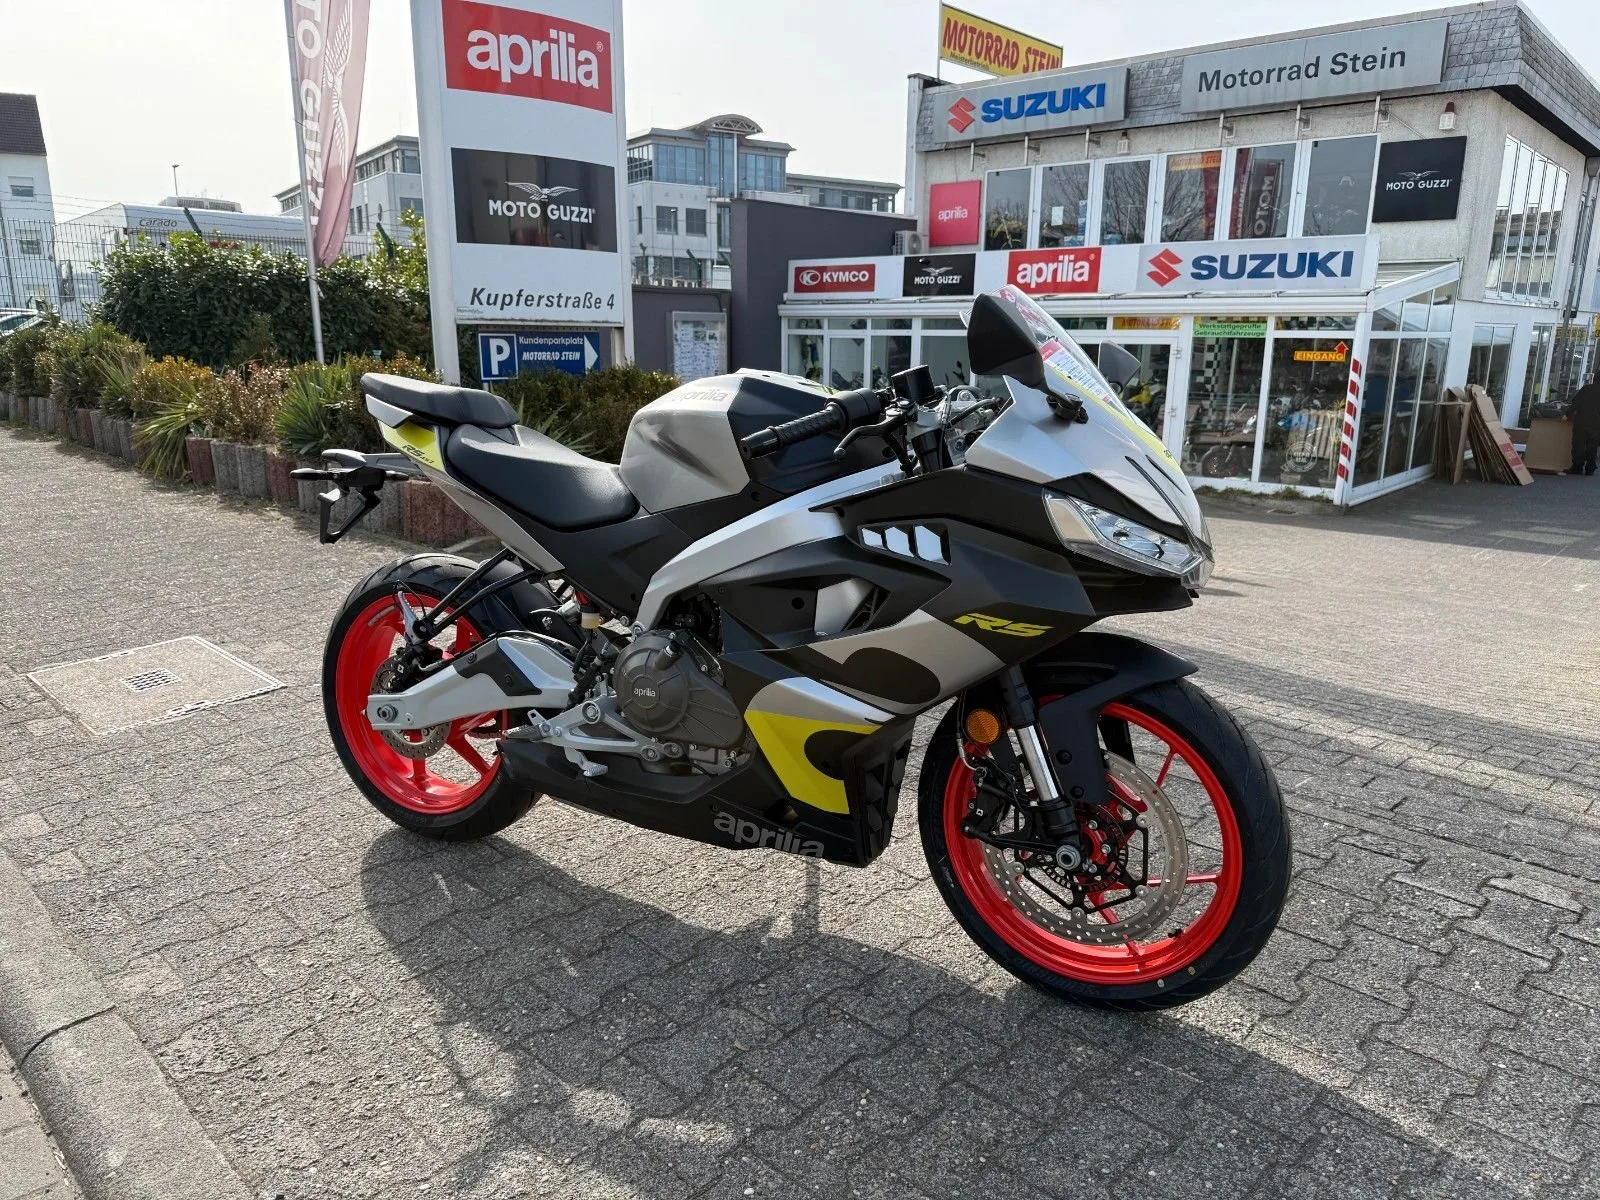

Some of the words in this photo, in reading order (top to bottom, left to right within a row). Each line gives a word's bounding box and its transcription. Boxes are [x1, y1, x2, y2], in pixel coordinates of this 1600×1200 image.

[942, 17, 1020, 70] MOTORRAD
[467, 29, 599, 89] aprilia
[1198, 55, 1321, 93] Motorrad
[1329, 46, 1407, 76] Stein
[981, 82, 1106, 124] SUZUKI
[1385, 180, 1415, 191] MOTO
[1418, 178, 1450, 189] GUZZI
[139, 217, 178, 228] Carado
[488, 199, 541, 219] MOTO
[547, 204, 593, 224] GUZZI
[937, 205, 969, 222] aprilia
[822, 270, 870, 283] KYMCO
[1016, 254, 1090, 289] aprilia
[1190, 250, 1354, 280] SUZUKI
[914, 276, 935, 285] MOTO
[937, 274, 962, 284] GUZZI
[470, 287, 602, 311] Kupferstraße
[606, 293, 615, 310] 4
[519, 336, 584, 346] Kundenparkplatz
[489, 338, 511, 376] P
[522, 351, 560, 361] MOTORRAD
[561, 351, 581, 361] STEIN
[1296, 351, 1344, 361] EINGANG
[402, 444, 425, 456] RS
[953, 612, 1056, 637] RS
[633, 687, 656, 697] aprilia
[713, 811, 825, 859] aprilia
